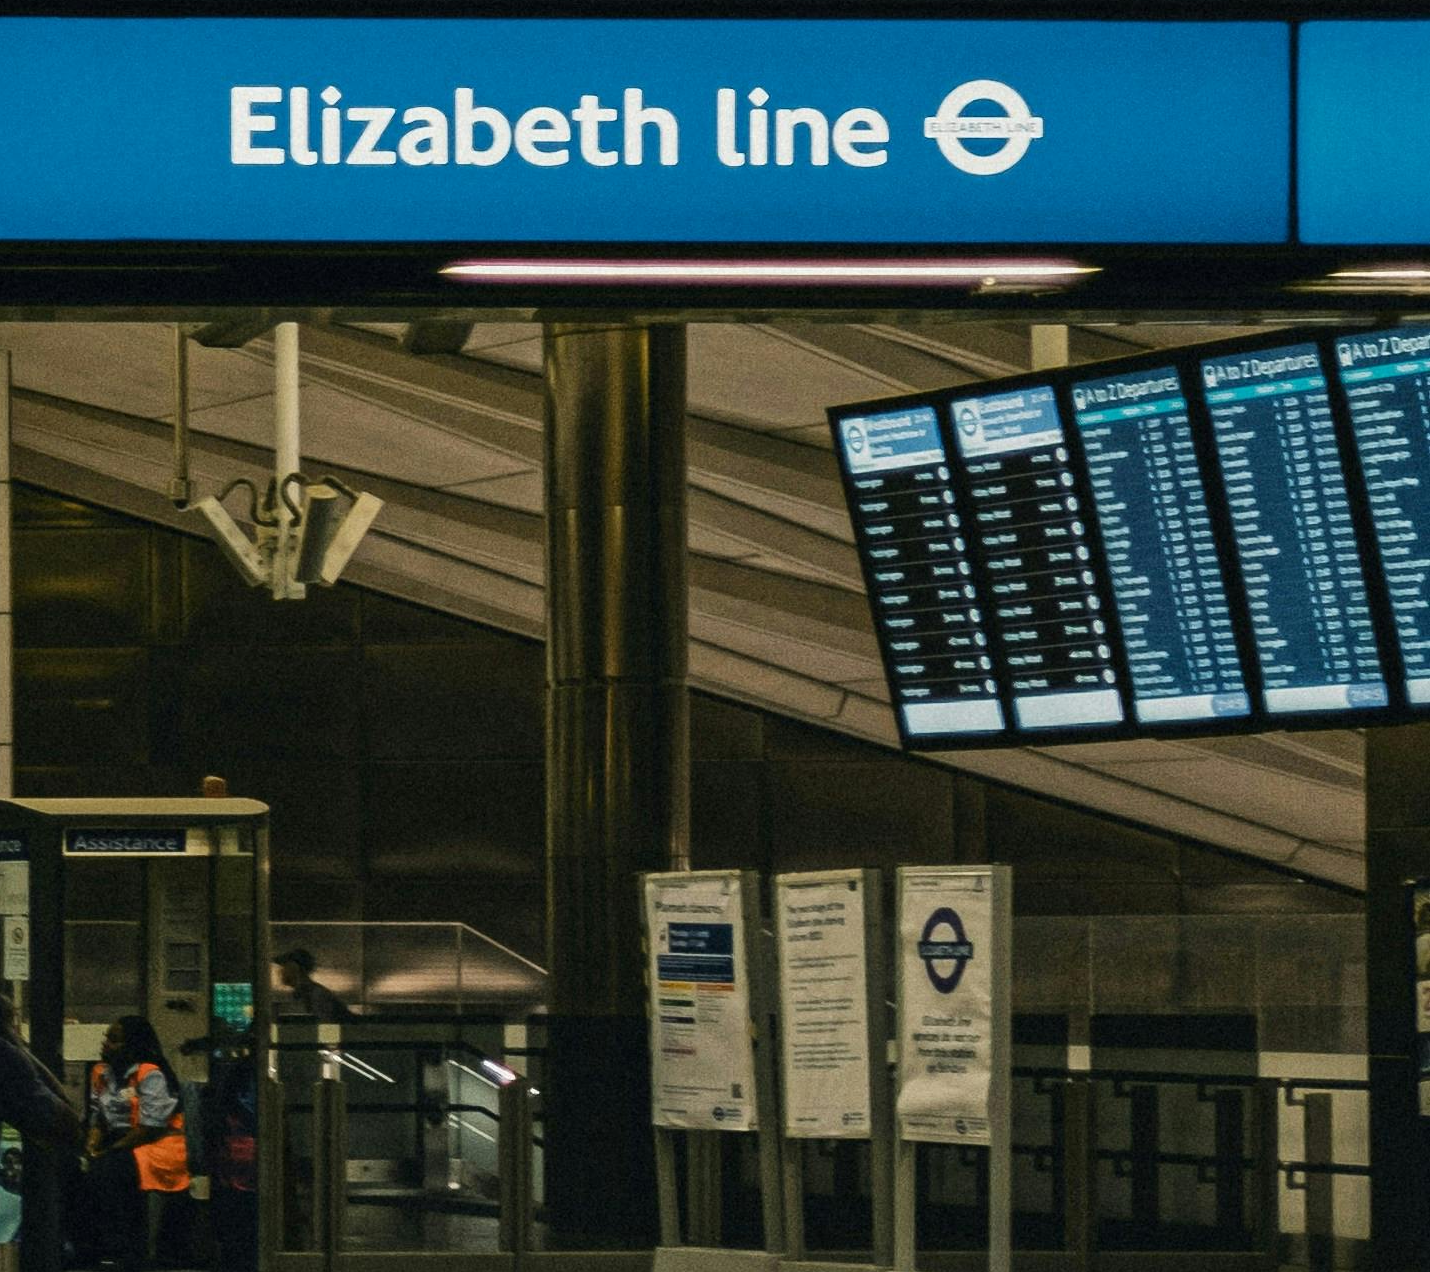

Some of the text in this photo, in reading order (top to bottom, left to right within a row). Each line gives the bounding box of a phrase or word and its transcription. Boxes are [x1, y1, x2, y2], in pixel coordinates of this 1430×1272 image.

[231, 86, 889, 167] Elizabeth line
[1248, 353, 1319, 377] Departures
[1114, 376, 1180, 402] Departures
[73, 834, 178, 851] Assistance
